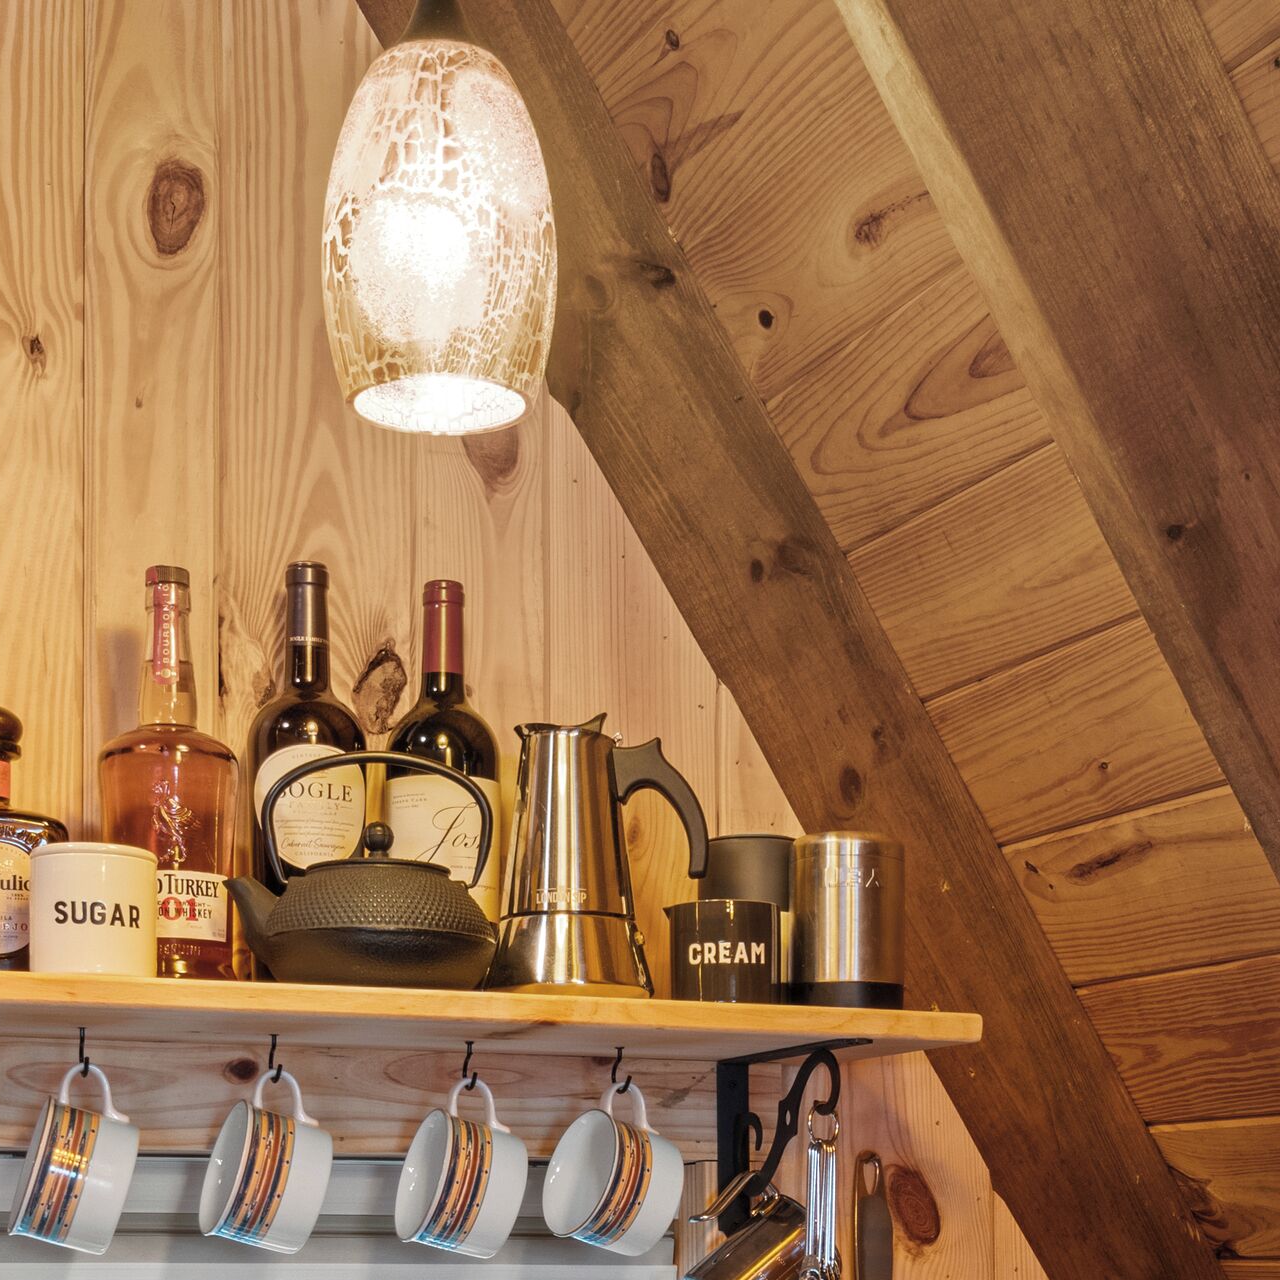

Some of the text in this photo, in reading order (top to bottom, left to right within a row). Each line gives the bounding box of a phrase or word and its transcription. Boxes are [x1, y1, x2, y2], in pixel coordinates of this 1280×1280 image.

[162, 605, 170, 664] BOURBON
[164, 873, 220, 899] TURKEY
[54, 900, 140, 929] SUGAR
[688, 941, 766, 965] CREAM
